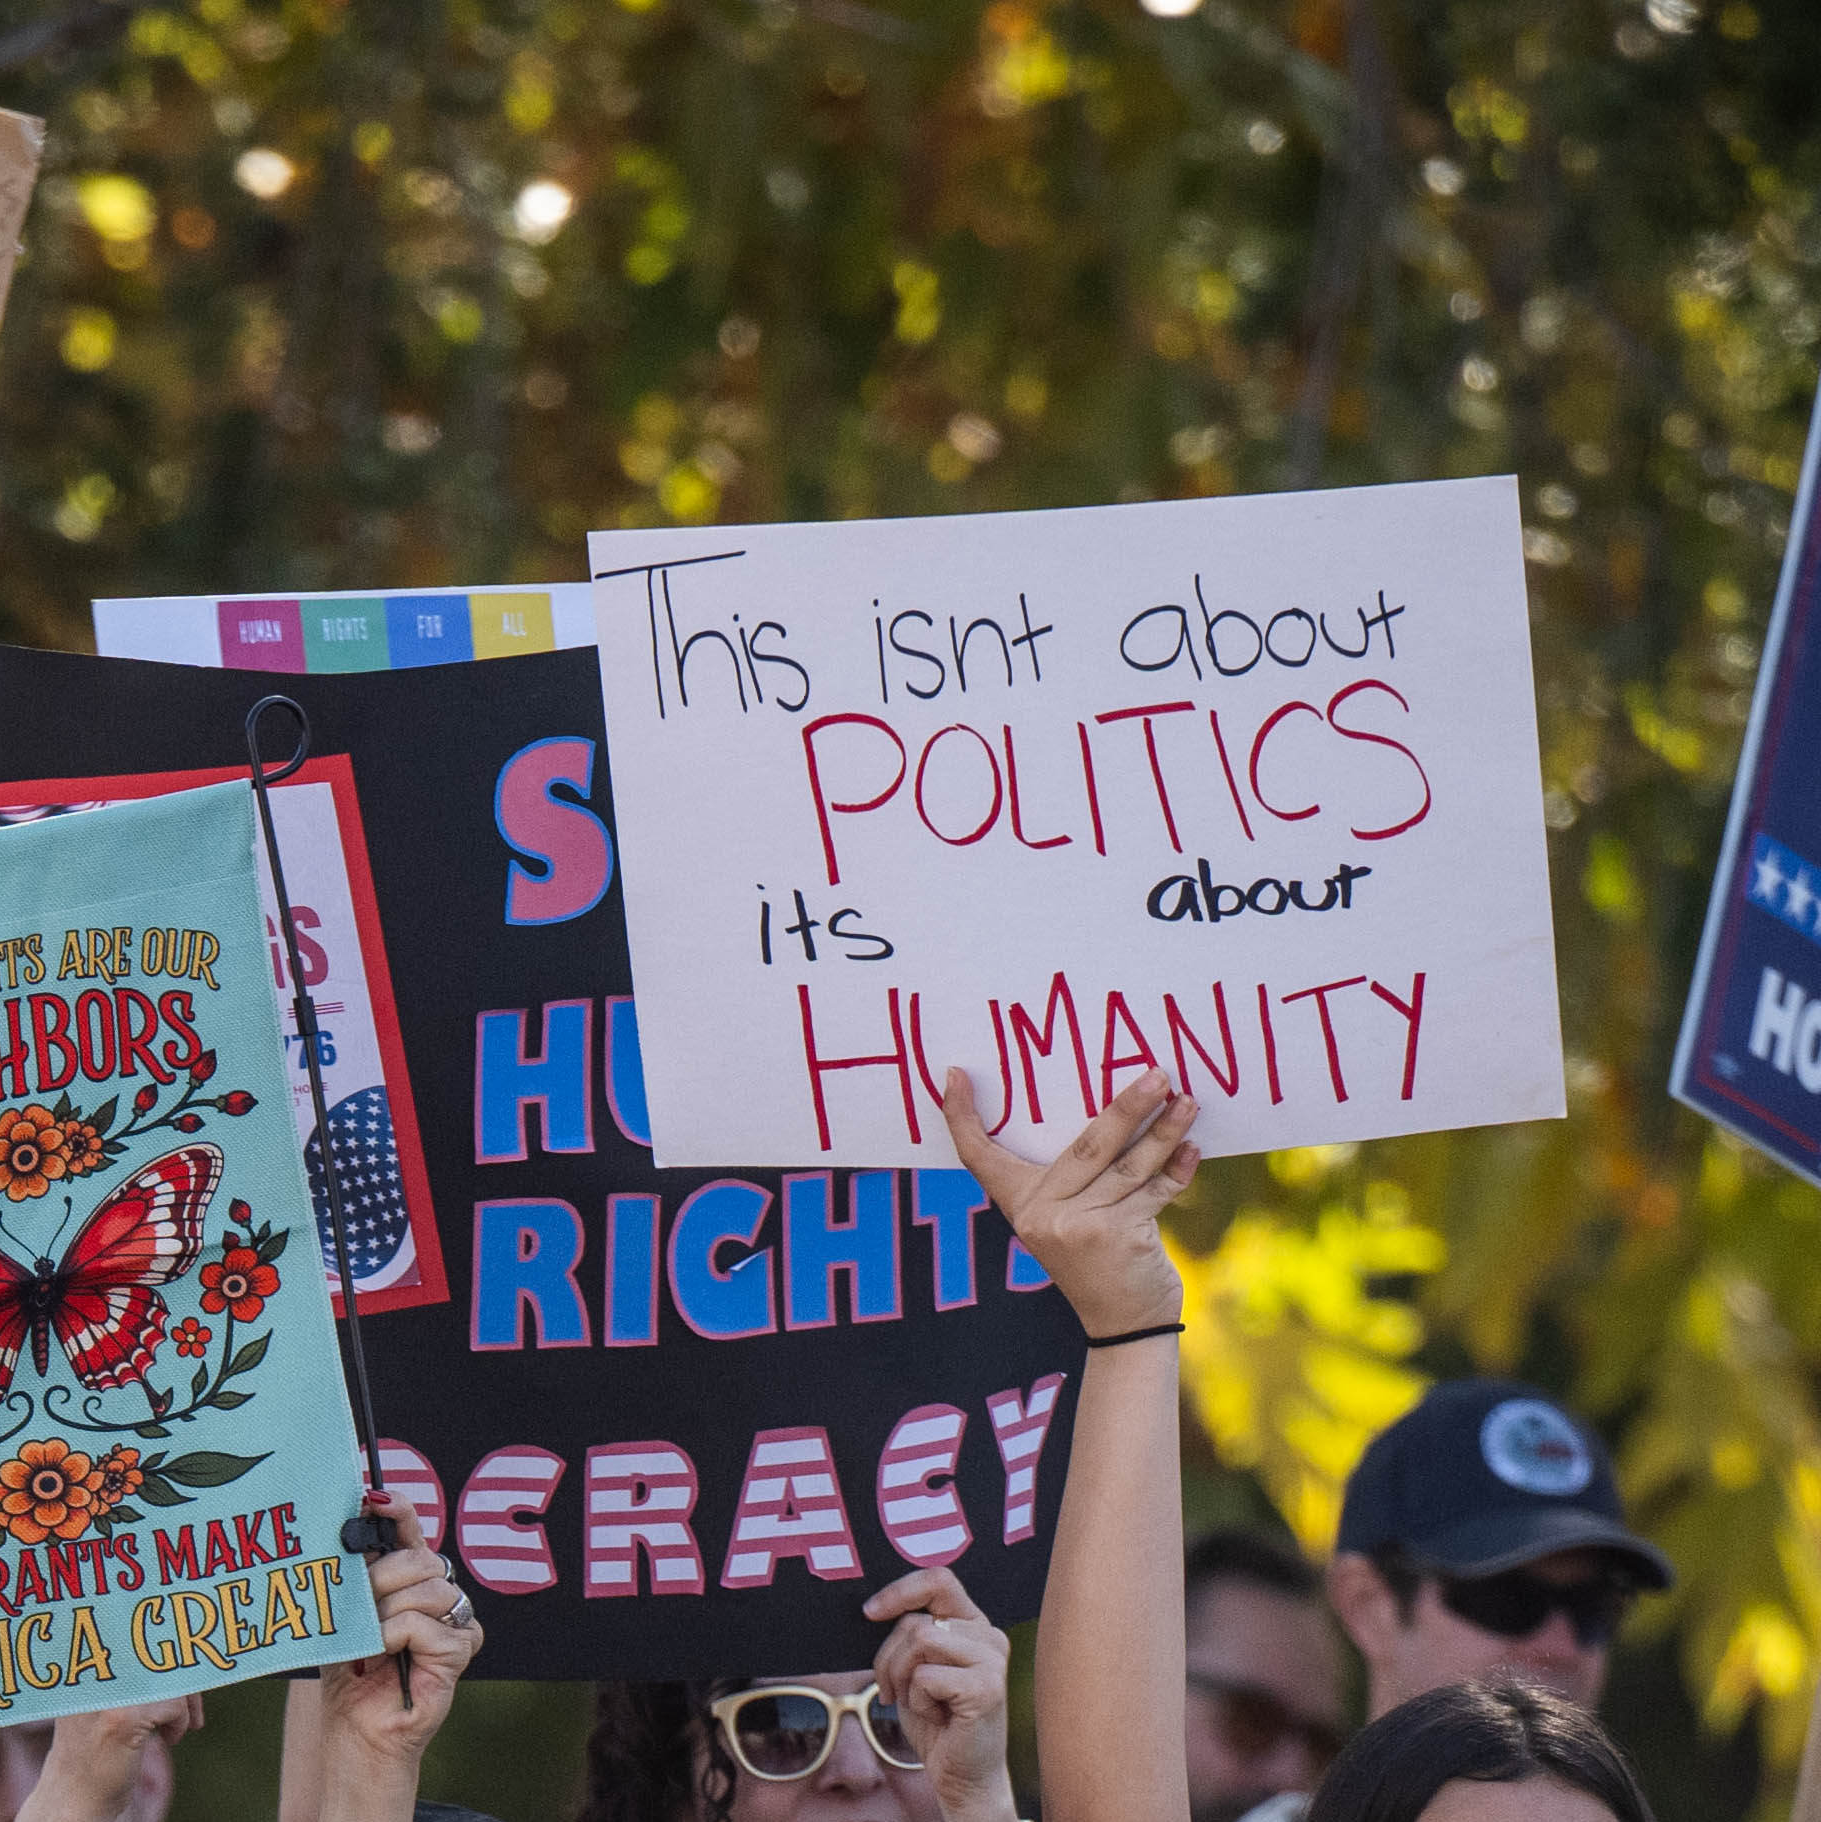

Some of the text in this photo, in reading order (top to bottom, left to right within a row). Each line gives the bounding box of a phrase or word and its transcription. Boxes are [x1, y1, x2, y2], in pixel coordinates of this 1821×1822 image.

[238, 611, 527, 644] HUMAN RIGHTS FOR ALL
[595, 550, 1407, 719] This isnt about
[801, 678, 1432, 886] POLITICS
[57, 926, 133, 983] ARE
[141, 926, 222, 990] OUR
[756, 857, 1373, 965] its about
[796, 971, 1427, 1152] HUMANITY
[470, 1166, 1055, 1352] RIGHT
[154, 1501, 302, 1587] MAKE
[130, 1556, 344, 1674] GREAT
